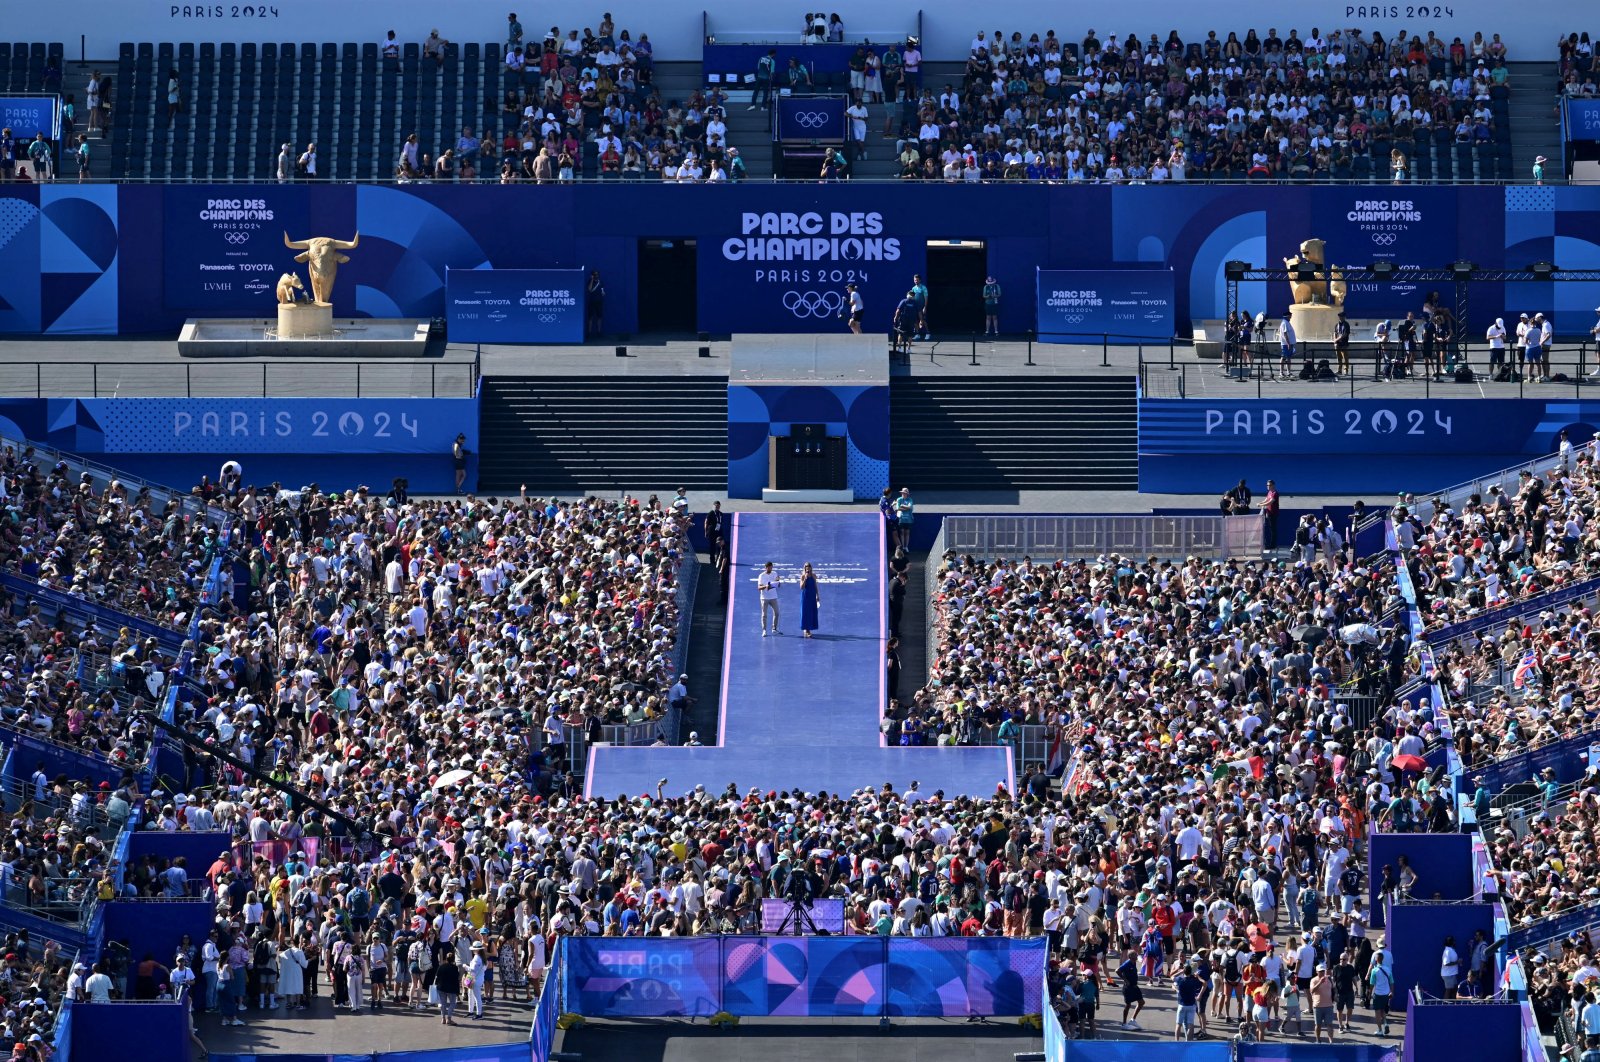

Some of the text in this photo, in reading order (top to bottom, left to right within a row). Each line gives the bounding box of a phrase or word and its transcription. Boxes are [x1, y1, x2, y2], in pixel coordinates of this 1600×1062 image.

[231, 6, 278, 17] 2024
[1406, 6, 1453, 18] 2024
[5, 119, 39, 128] 2024
[207, 199, 266, 210] PARC DES
[1355, 200, 1414, 210] PARC DES
[200, 210, 274, 220] CHAMPIONS
[1347, 211, 1421, 221] CHAMPIONS
[742, 212, 883, 234] PARC DES
[722, 238, 900, 260] CHAMPIONS
[818, 270, 868, 282] 2024
[525, 289, 570, 297] PARC DES
[1351, 284, 1378, 292] LVMH
[1052, 290, 1097, 298] PARC DES
[1046, 298, 1102, 306] CHAMPIONS
[312, 411, 417, 437] 2024
[1344, 409, 1452, 434] 2024
[928, 882, 938, 896] 10
